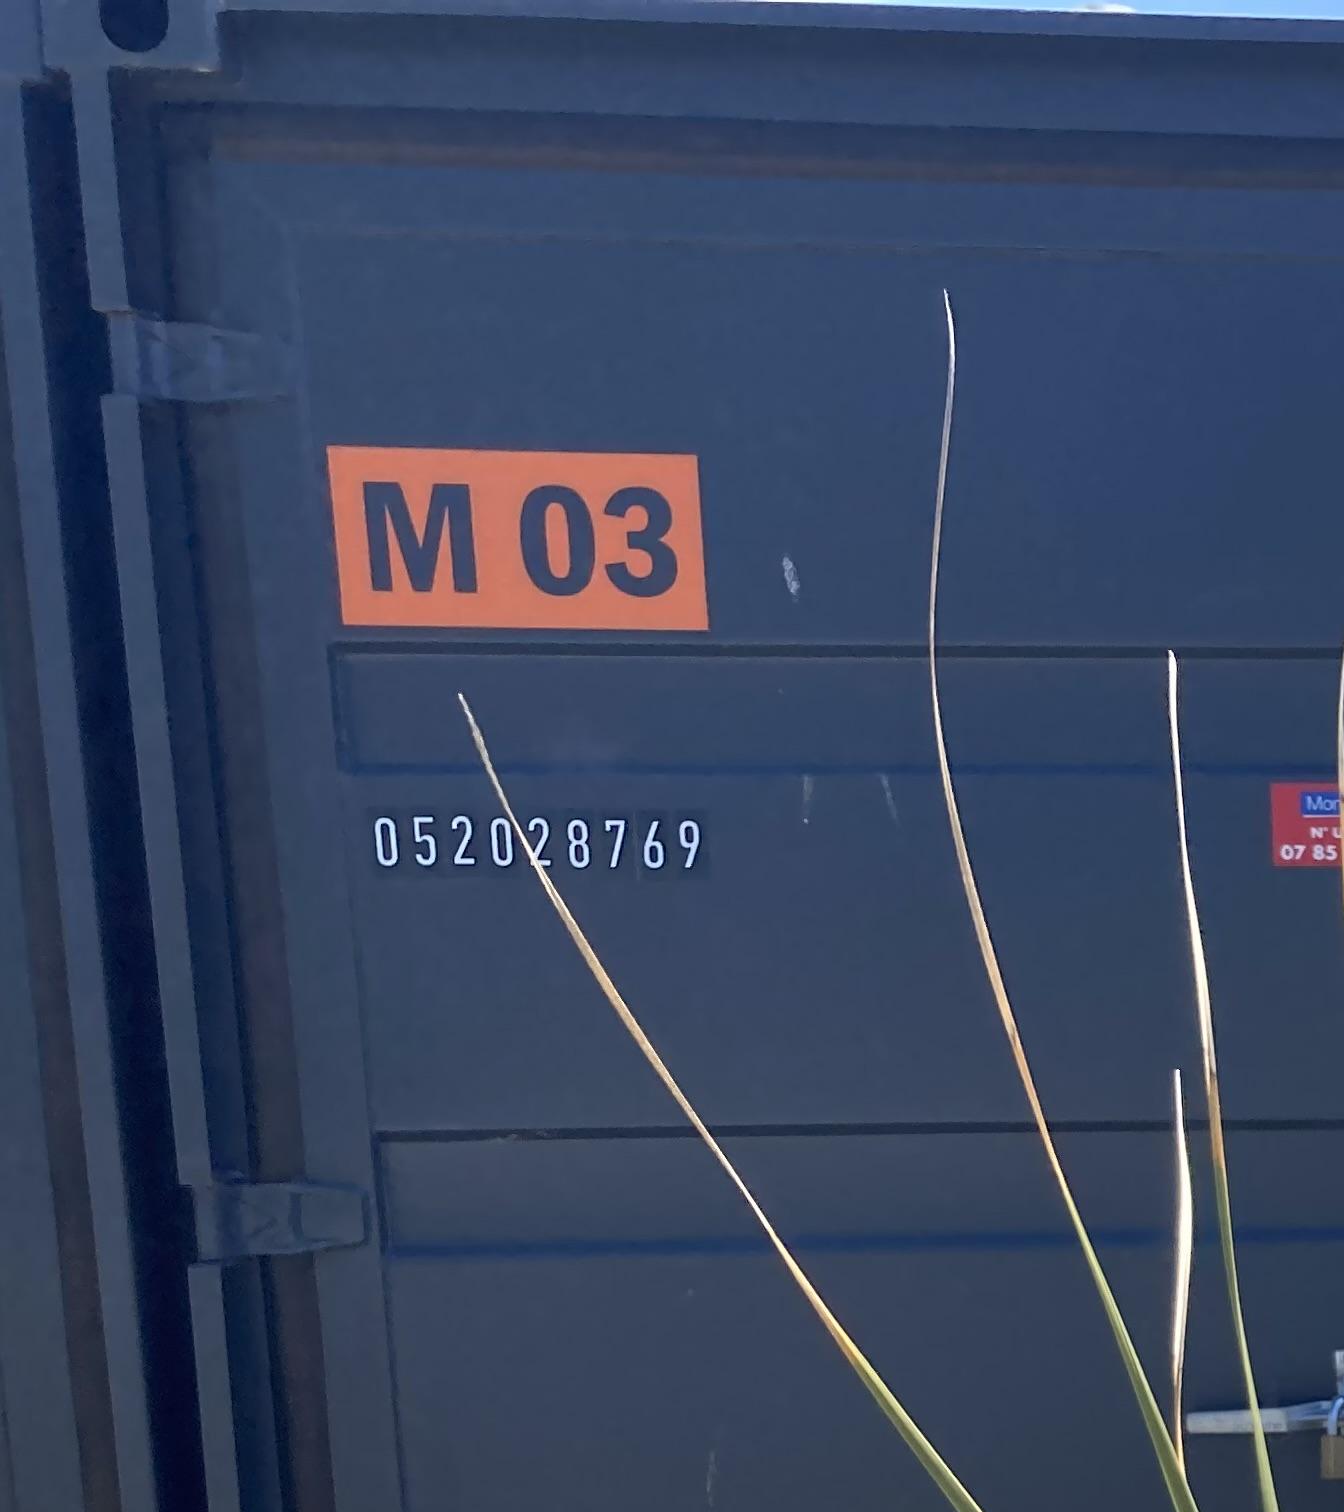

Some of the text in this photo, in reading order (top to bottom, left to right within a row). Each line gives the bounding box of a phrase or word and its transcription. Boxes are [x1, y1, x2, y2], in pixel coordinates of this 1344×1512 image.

[363, 482, 678, 597] M 03
[374, 815, 701, 868] 052028769
[1280, 845, 1305, 860] 07
[1312, 845, 1338, 860] 85
